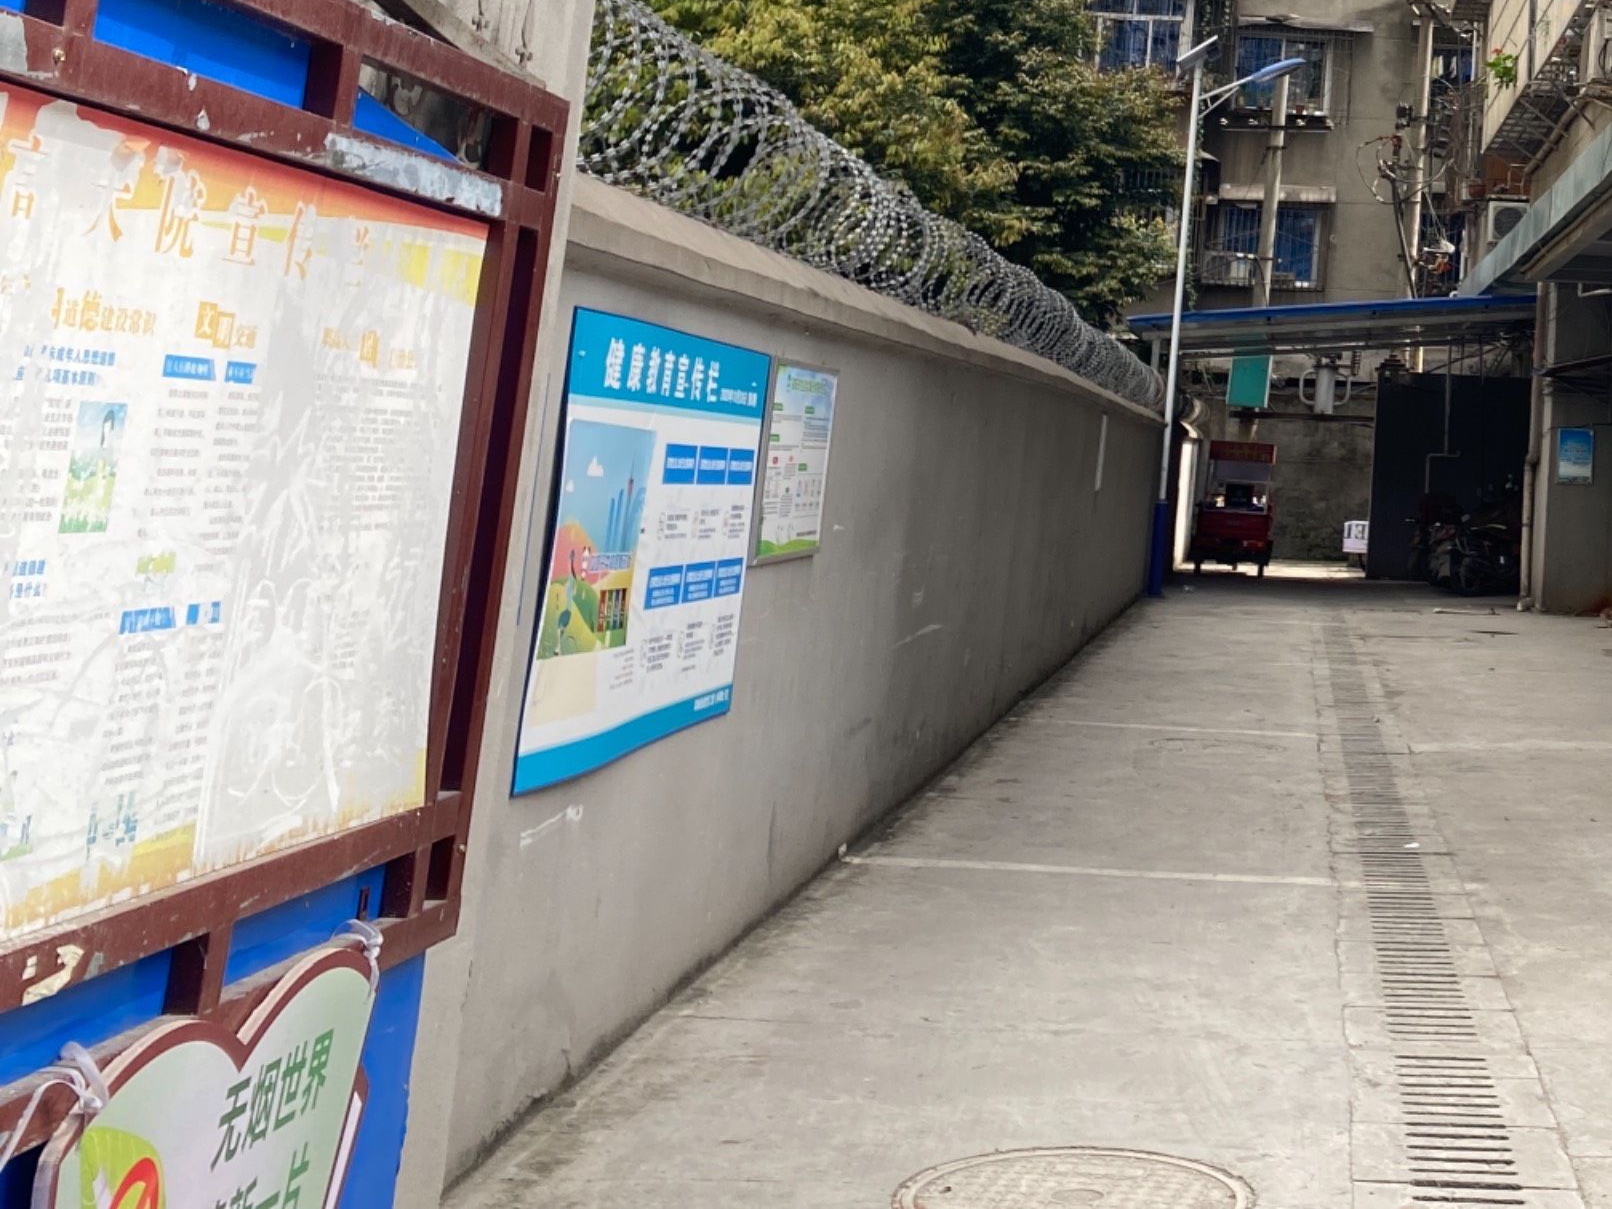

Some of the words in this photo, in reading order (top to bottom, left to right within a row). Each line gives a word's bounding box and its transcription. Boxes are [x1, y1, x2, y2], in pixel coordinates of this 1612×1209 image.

[603, 337, 720, 403] 健康教育宣传栏
[211, 1029, 334, 1172] 无烟世界
